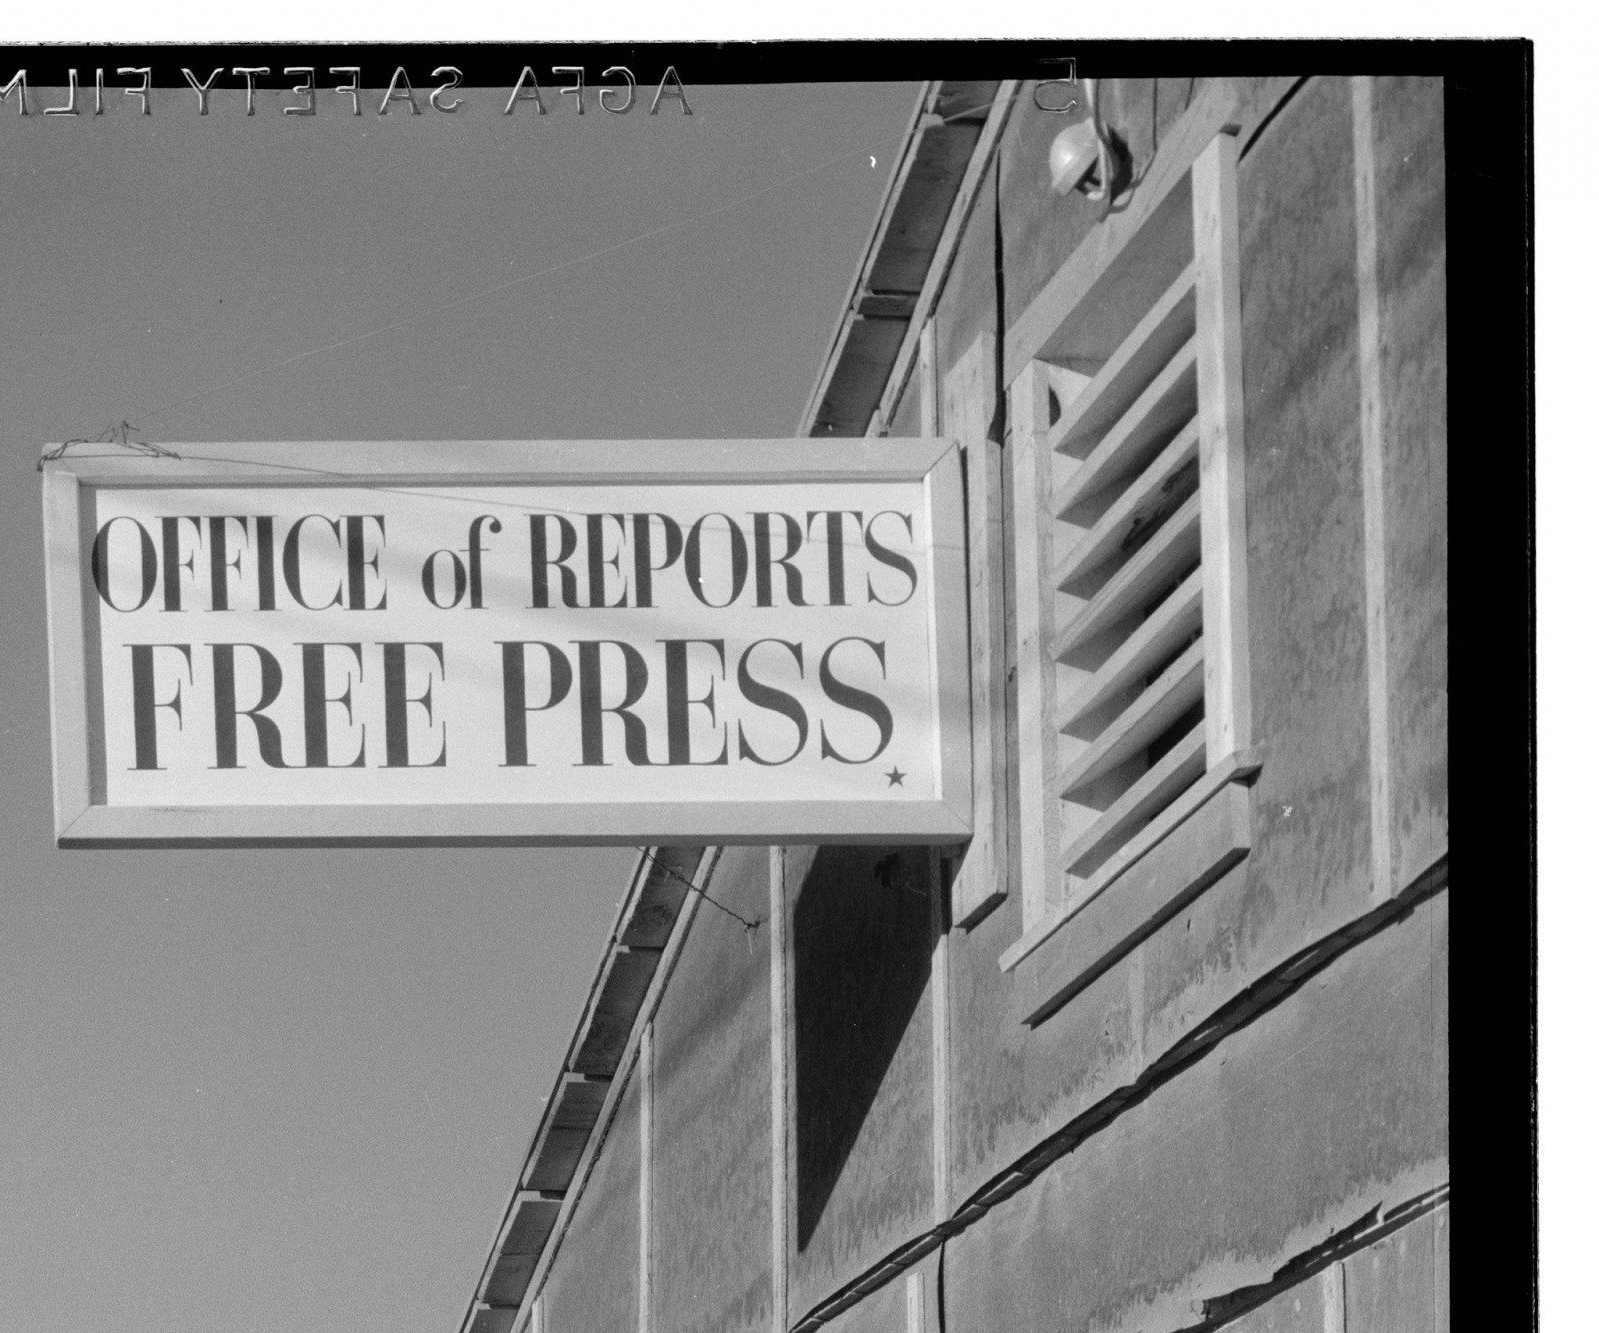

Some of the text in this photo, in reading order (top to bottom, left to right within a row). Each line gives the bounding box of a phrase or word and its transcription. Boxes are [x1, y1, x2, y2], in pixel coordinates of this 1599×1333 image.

[91, 510, 919, 613] OFFICE of REPORTS
[123, 636, 895, 771] FREE PRESS
